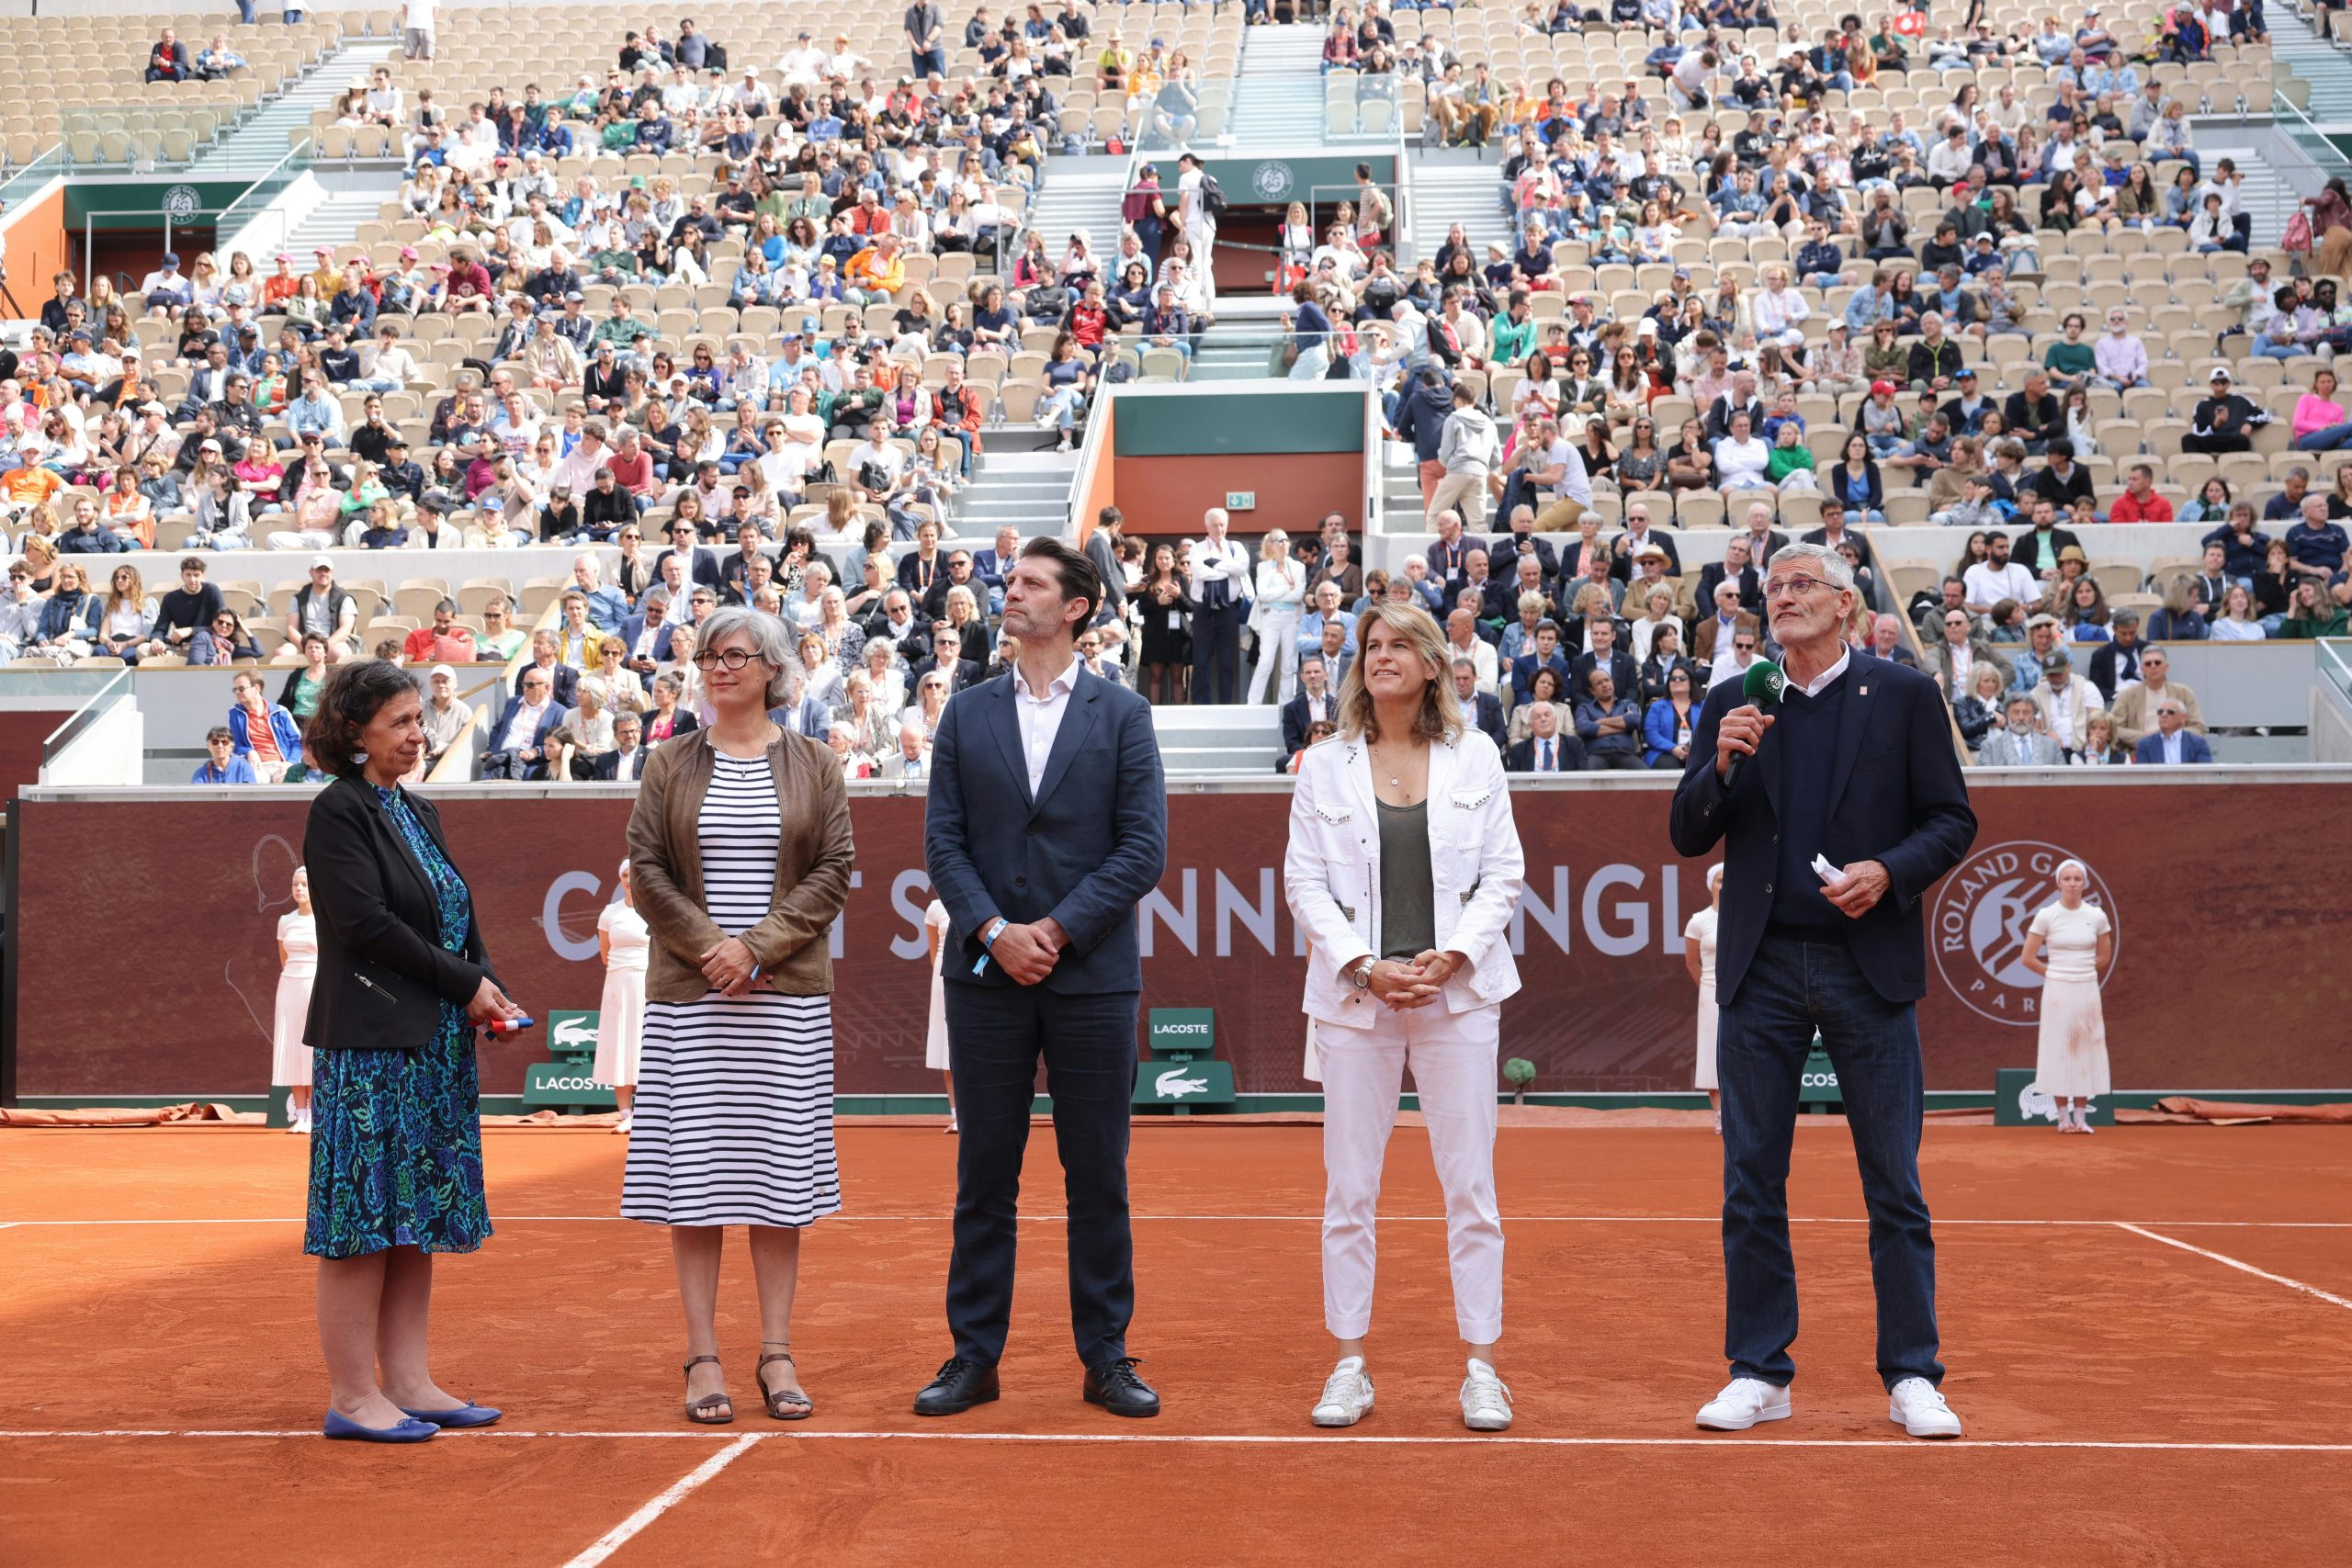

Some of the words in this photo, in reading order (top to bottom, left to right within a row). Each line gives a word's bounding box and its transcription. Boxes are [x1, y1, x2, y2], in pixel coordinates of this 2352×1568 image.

[1942, 852, 2018, 953] ROLAND
[1971, 978, 2035, 1012] PAR
[1154, 1024, 1209, 1034] LACOSTE
